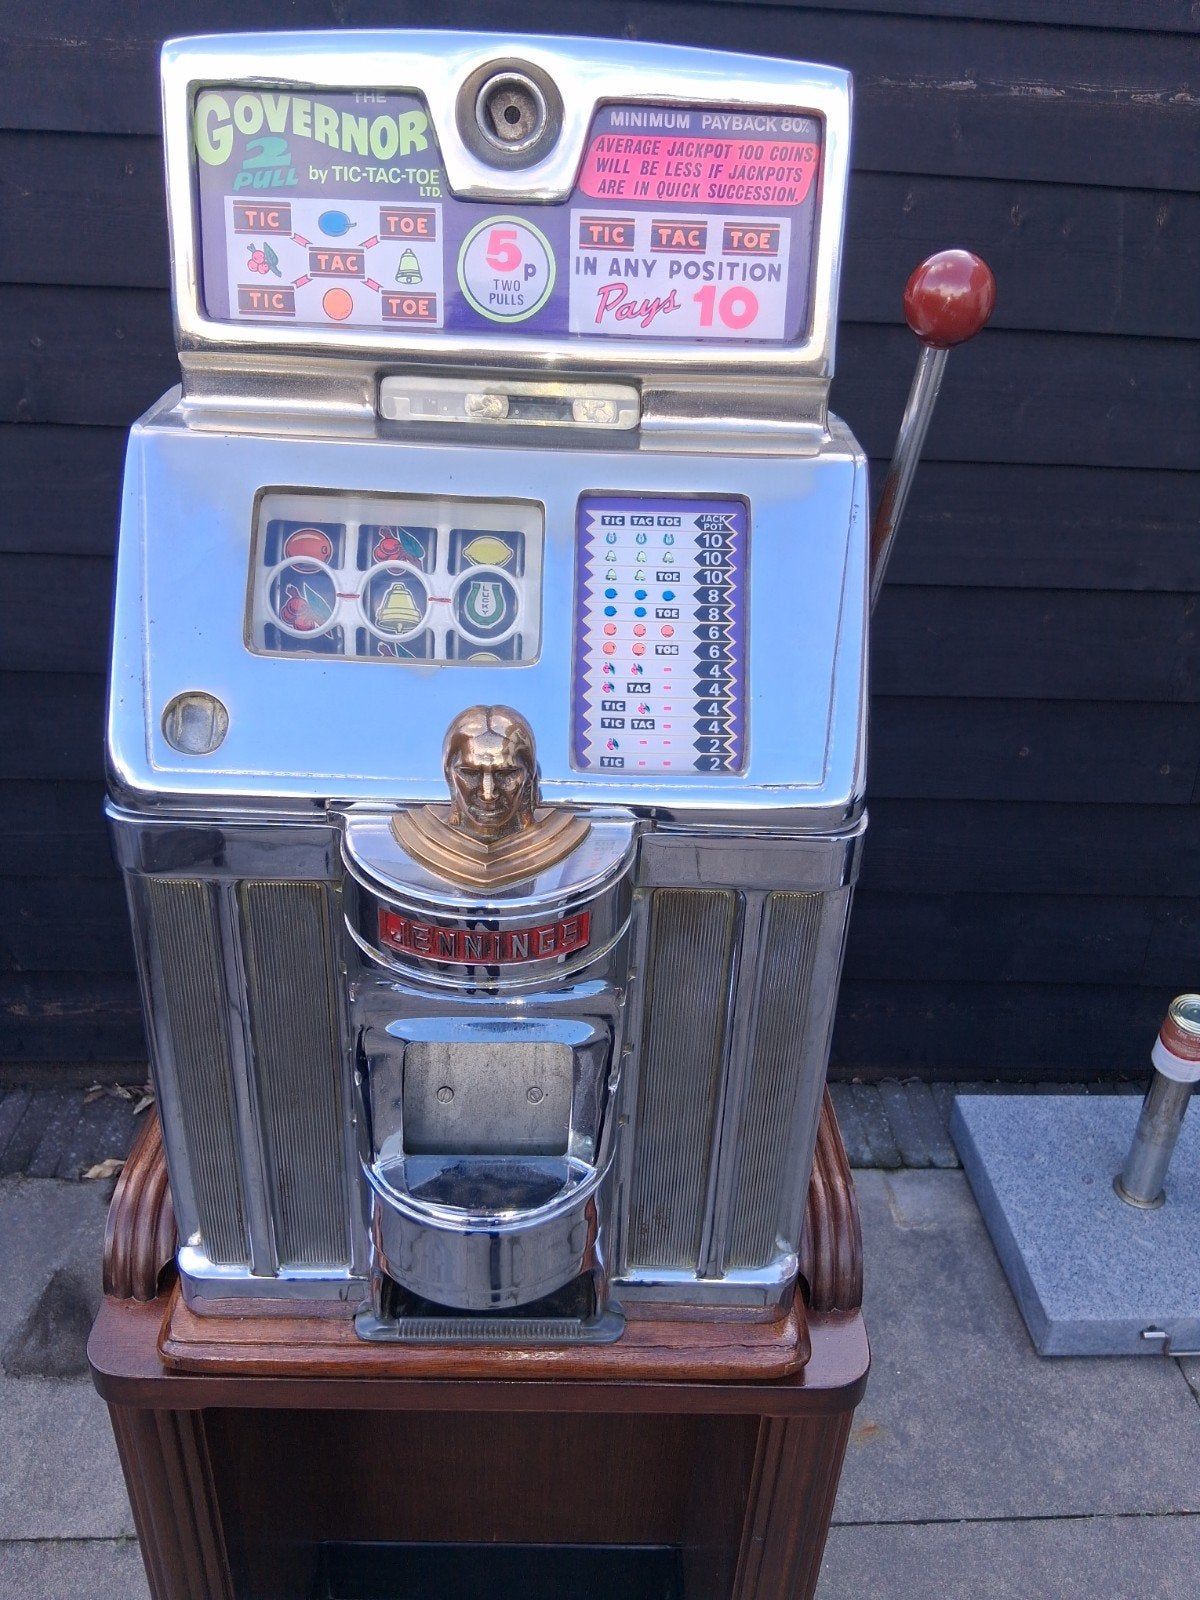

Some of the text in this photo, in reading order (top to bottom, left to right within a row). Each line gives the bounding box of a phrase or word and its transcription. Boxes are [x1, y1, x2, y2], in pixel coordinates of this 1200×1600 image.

[352, 91, 387, 103] THE
[610, 111, 810, 134] MINIMUM PAYBACK 80%
[196, 94, 428, 166] GOVERNOR
[242, 136, 291, 169] 2
[596, 137, 661, 155] AVERAGE
[667, 141, 733, 160] JACKPOT
[738, 144, 766, 161] 100
[309, 165, 440, 185] by TIC-TAC-TOE
[596, 157, 803, 183] WILL BE LESS IF JACKPOTS
[232, 168, 299, 192] PULL
[420, 186, 442, 198] LTD.
[597, 179, 798, 202] ARE IN QUICK SUCCESSION.
[245, 211, 280, 228] TIC
[386, 216, 428, 234] TOE
[588, 225, 771, 250] TIC TAC TOE
[317, 254, 358, 271] TAC
[575, 256, 782, 282] IN ANY POSITION
[493, 279, 521, 292] TWO
[250, 292, 284, 309] TIC
[489, 293, 524, 307] PULLS
[595, 282, 759, 330] Pays 10
[388, 298, 429, 316] TOE
[604, 517, 680, 526] TIC TAC TOE
[701, 515, 726, 523] JACK
[704, 523, 723, 531] POT
[703, 534, 723, 548] 10
[703, 552, 722, 565] 10
[658, 572, 679, 581] TOE
[703, 570, 723, 584] 10
[482, 585, 490, 615] LUCKY
[708, 590, 719, 603] 8
[657, 609, 678, 618] TOE
[708, 608, 720, 621] 8
[708, 626, 720, 639] 6
[656, 646, 678, 655] TOE
[709, 645, 720, 658] 6
[709, 665, 721, 678] 4
[629, 684, 650, 693] TAC
[709, 684, 720, 696] 4
[604, 702, 624, 711] TIC
[708, 702, 719, 715] 4
[603, 719, 654, 729] TIC TAC
[708, 721, 720, 733] 4
[709, 739, 720, 752] 2
[602, 758, 622, 767] TIC
[709, 758, 720, 771] 2
